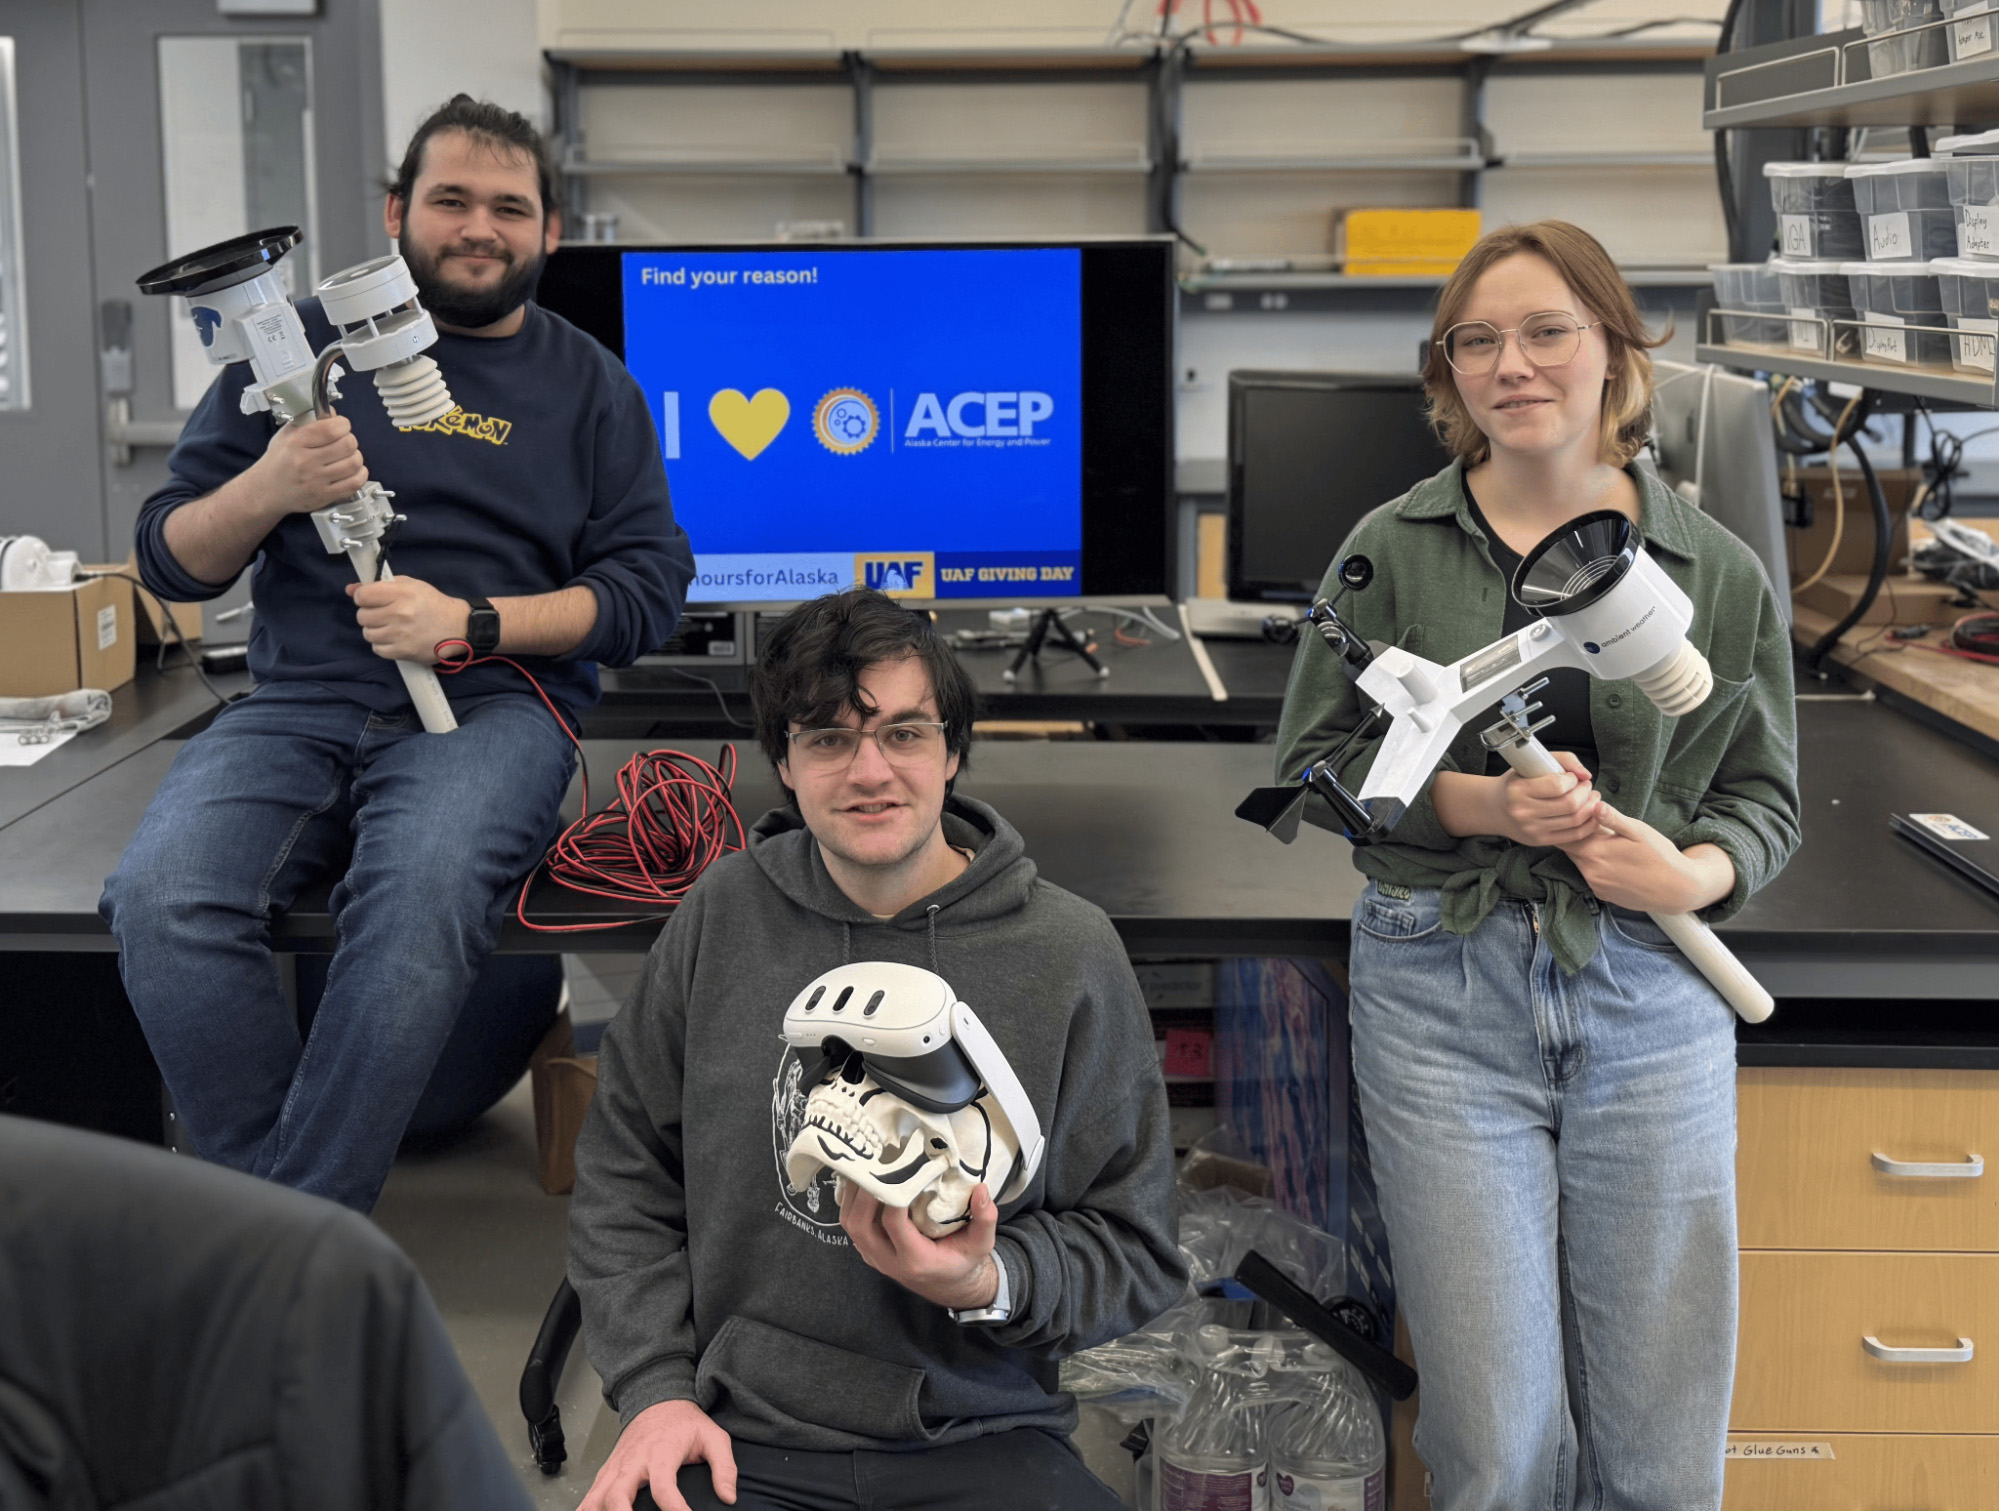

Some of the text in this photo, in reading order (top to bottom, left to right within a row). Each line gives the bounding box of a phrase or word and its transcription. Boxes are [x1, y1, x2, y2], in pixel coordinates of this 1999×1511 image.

[1872, 224, 1898, 252] Audio
[641, 266, 818, 290] Find your reason!
[664, 391, 680, 459] I
[904, 391, 1054, 437] ACEP
[904, 437, 1051, 448] Alaska Center for Energy and Power
[864, 561, 924, 590] UAF
[940, 566, 1075, 582] UAF GIVING DAY
[1601, 606, 1656, 648] ambient weather
[817, 1229, 849, 1246] ALASKA
[1743, 1444, 1773, 1456] Glue
[1776, 1445, 1806, 1456] Guns
